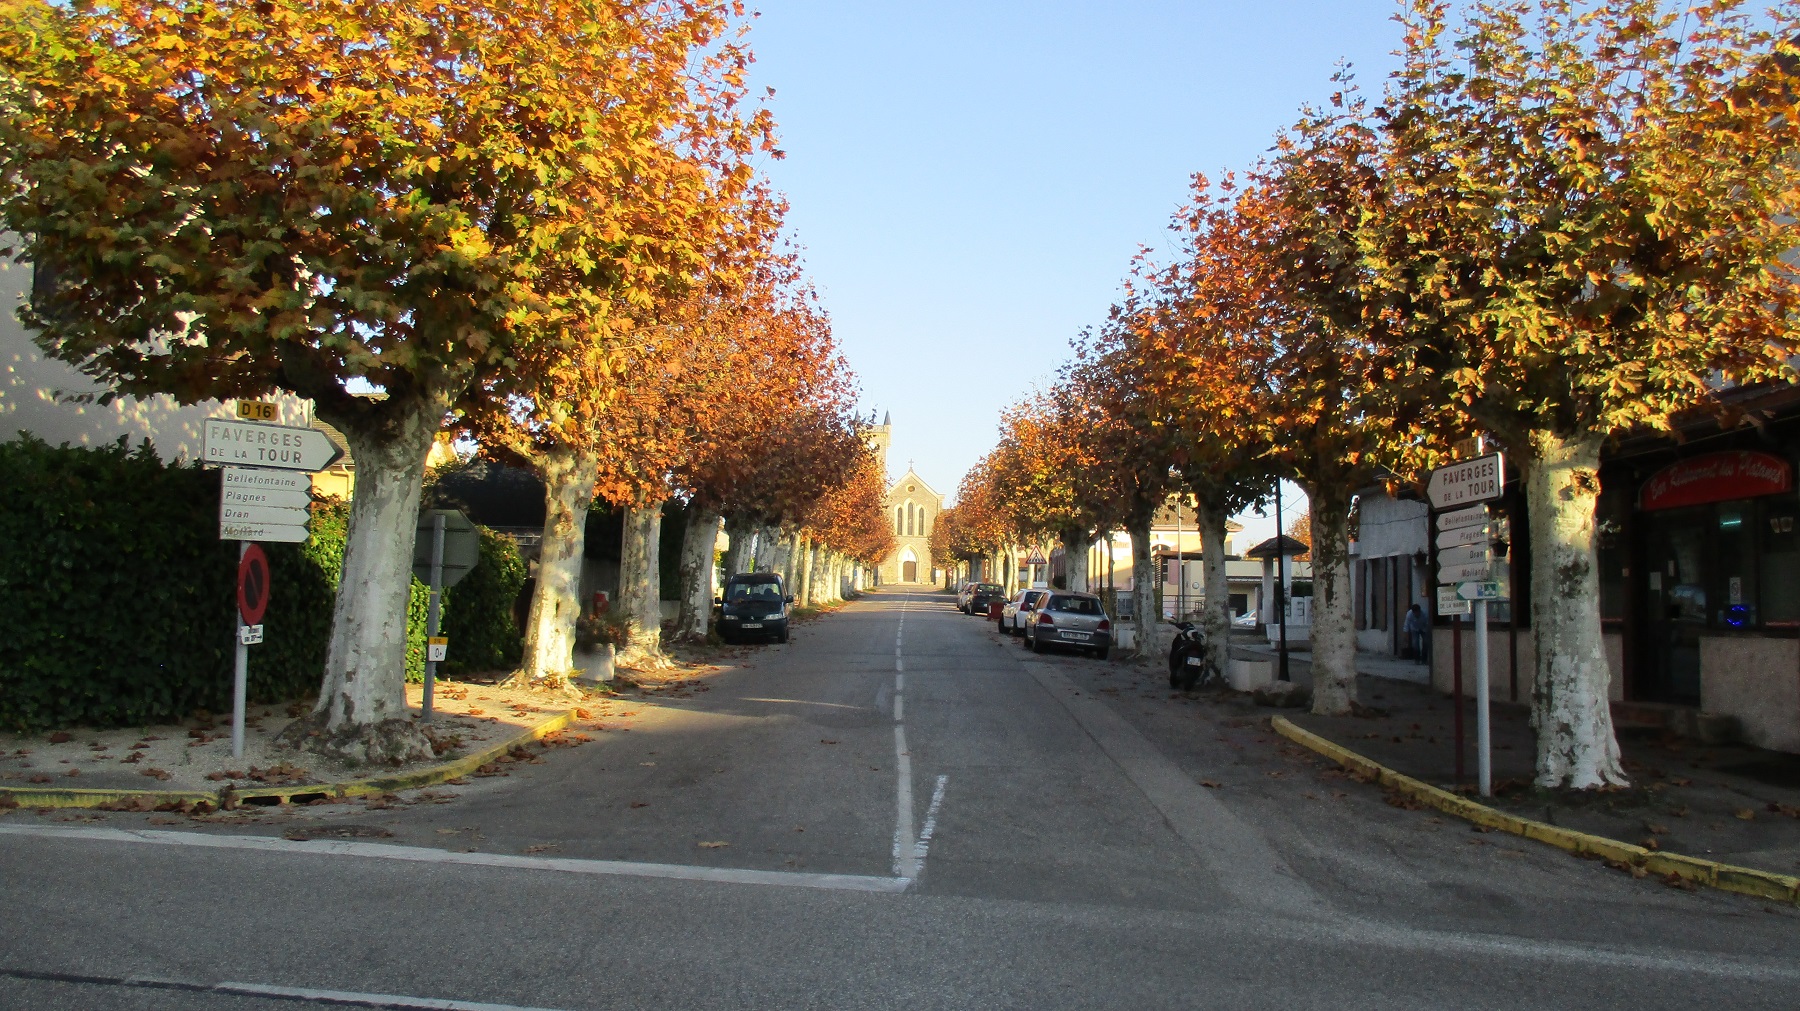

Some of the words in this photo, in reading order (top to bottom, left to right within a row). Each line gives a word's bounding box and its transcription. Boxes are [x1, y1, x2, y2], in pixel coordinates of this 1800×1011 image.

[242, 403, 250, 415] D
[211, 426, 303, 448] FAVERGES
[211, 447, 225, 457] DE
[234, 449, 248, 459] LA
[258, 447, 303, 464] TOUR
[226, 473, 297, 487] Bellefontaine
[1443, 462, 1495, 486] FAVERGES
[226, 491, 266, 502] Plagnes
[1443, 493, 1451, 502] DE
[1455, 490, 1463, 500] LA
[1468, 479, 1495, 497] TOUR
[224, 508, 249, 518] Dran
